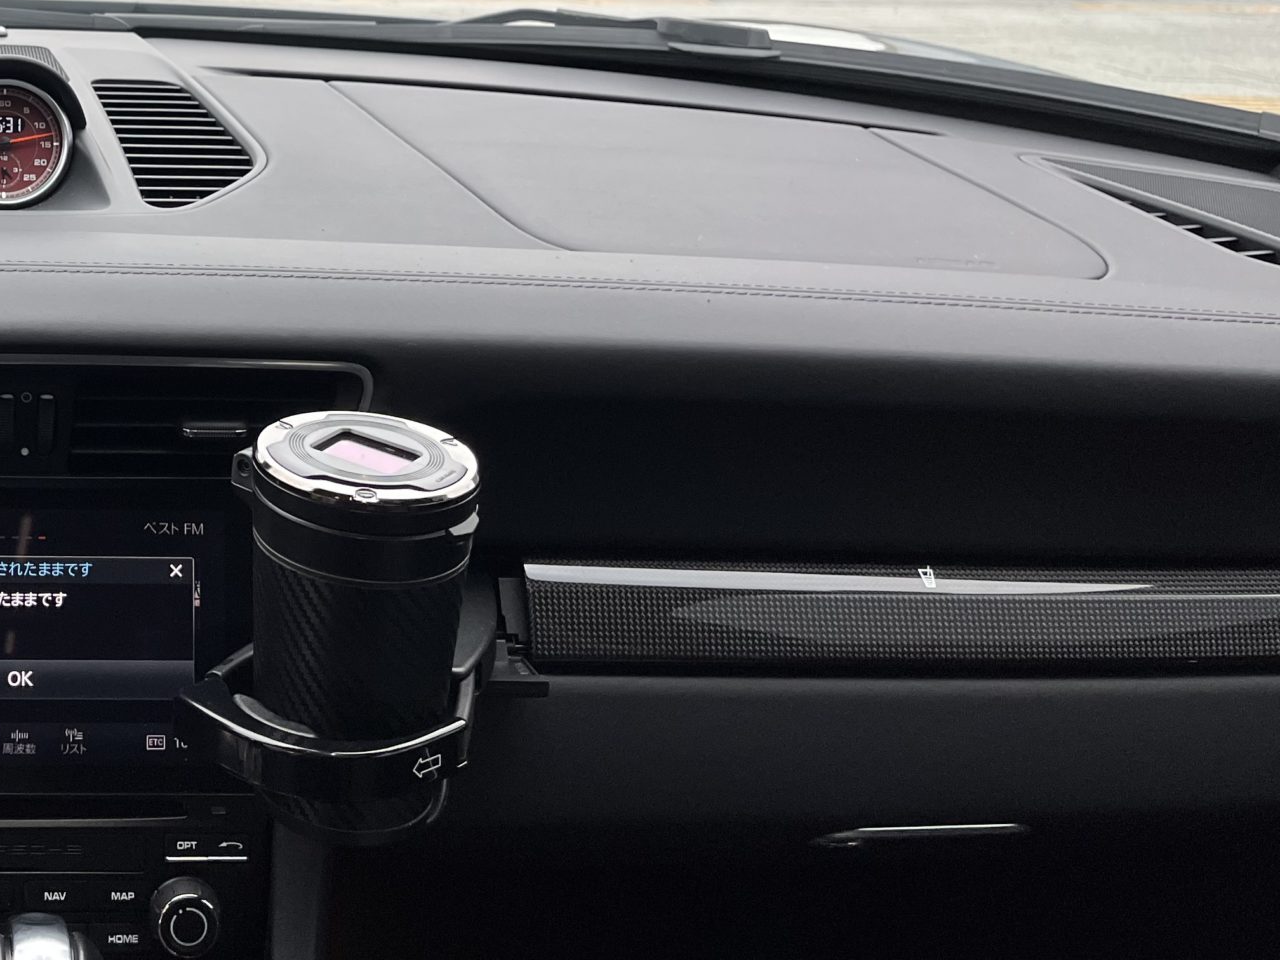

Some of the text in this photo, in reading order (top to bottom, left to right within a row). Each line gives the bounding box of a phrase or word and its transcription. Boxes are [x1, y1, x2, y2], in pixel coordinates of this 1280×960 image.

[23, 106, 30, 114] 5
[34, 122, 46, 130] 10
[40, 140, 52, 148] 15
[34, 158, 48, 166] 20
[143, 522, 204, 536] ベスト FM
[7, 671, 34, 688] OK
[148, 738, 163, 747] ETC
[2, 742, 36, 755] 周波数
[60, 743, 87, 754] リスト
[176, 840, 198, 850] OPT
[44, 892, 66, 902] NAV
[111, 892, 135, 902] MAP
[108, 934, 138, 944] HOME
